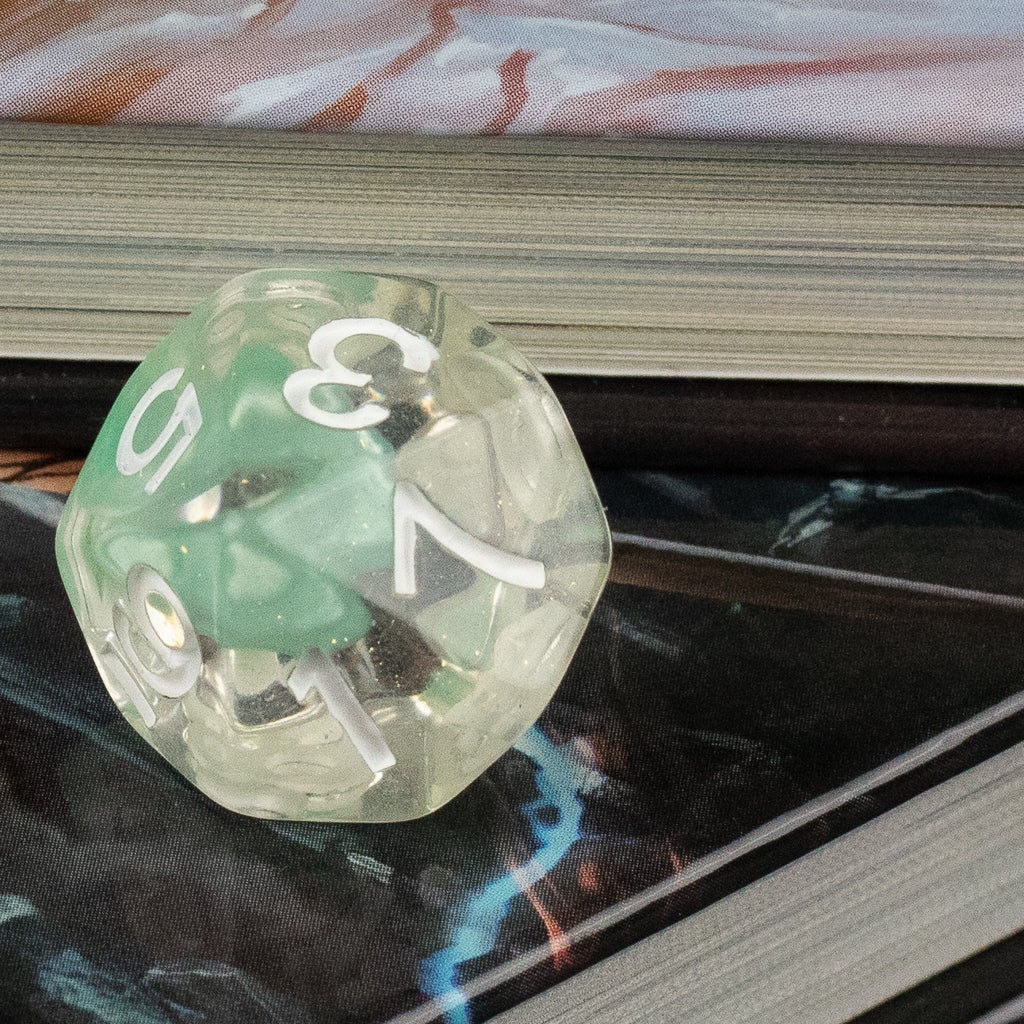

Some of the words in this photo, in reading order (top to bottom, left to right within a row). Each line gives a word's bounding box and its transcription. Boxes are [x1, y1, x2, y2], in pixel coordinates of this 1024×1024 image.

[115, 366, 204, 495] 5
[283, 317, 440, 430] 3
[393, 480, 546, 595] 7
[287, 645, 397, 774] 1
